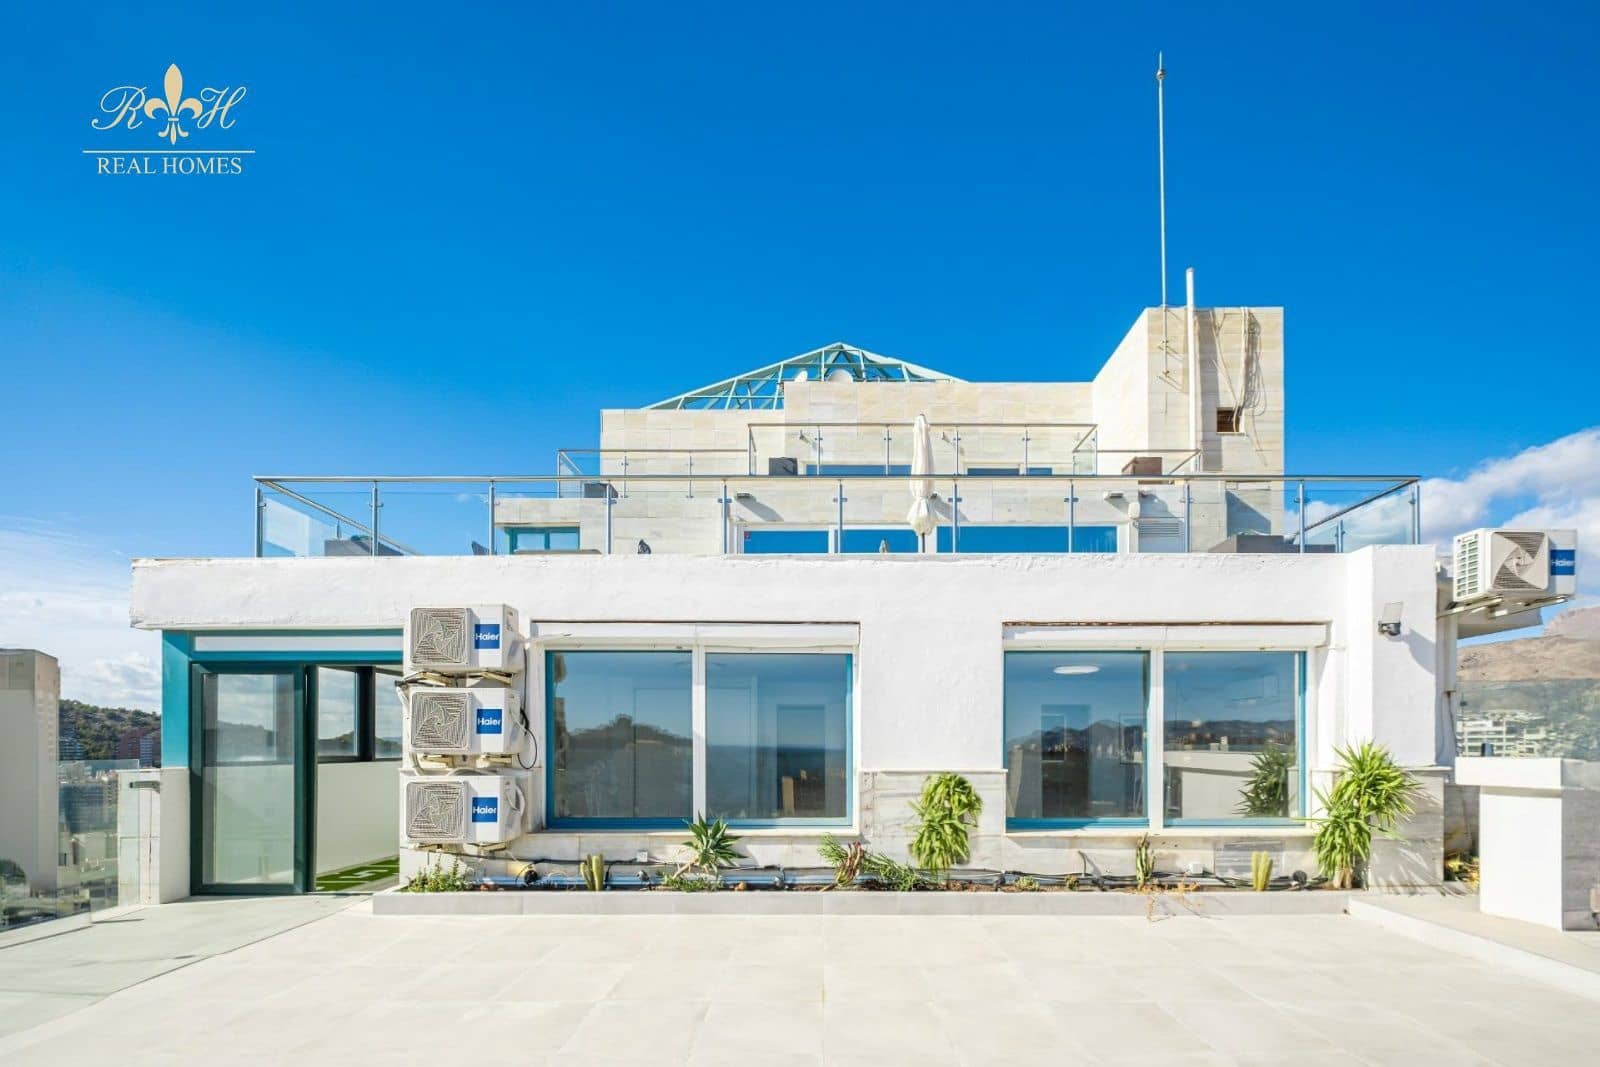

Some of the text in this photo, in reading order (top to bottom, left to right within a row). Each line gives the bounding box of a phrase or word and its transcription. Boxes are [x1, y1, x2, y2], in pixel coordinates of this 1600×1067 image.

[1551, 558, 1575, 567] Haier
[475, 632, 500, 641] Haier
[477, 716, 501, 726] Haier
[472, 805, 497, 814] Haier
